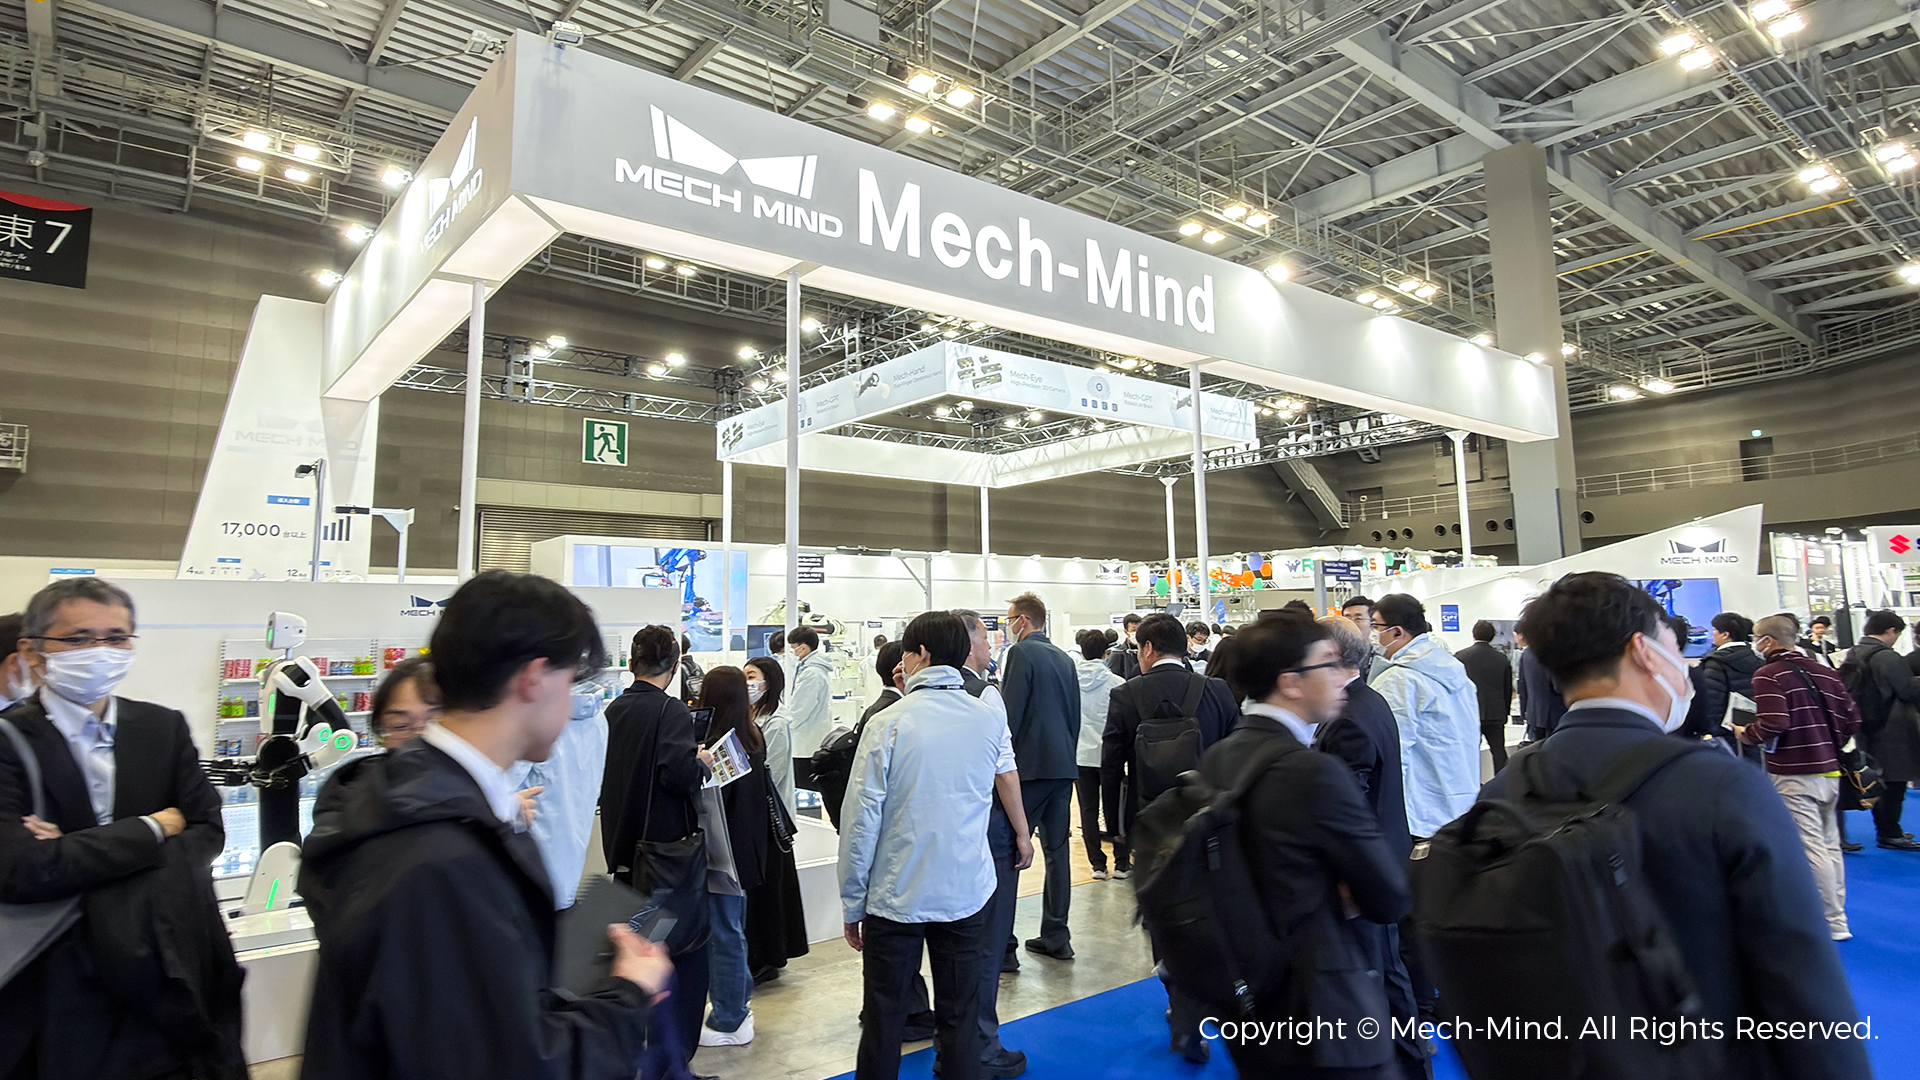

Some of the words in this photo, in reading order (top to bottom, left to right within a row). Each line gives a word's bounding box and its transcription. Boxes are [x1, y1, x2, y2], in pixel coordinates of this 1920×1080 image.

[451, 168, 483, 222] MIND
[615, 157, 742, 214] MECH
[753, 194, 844, 238] MIND
[858, 167, 1216, 335] Mech-Mind
[1010, 370, 1043, 383] Mech-Eye
[1123, 391, 1153, 402] Mech-GPT
[235, 431, 301, 446] MECH
[308, 437, 359, 451] MD
[221, 521, 281, 539] 17,000
[1284, 558, 1314, 573] WR
[1660, 556, 1701, 565] MECH
[1704, 555, 1739, 563] MIND
